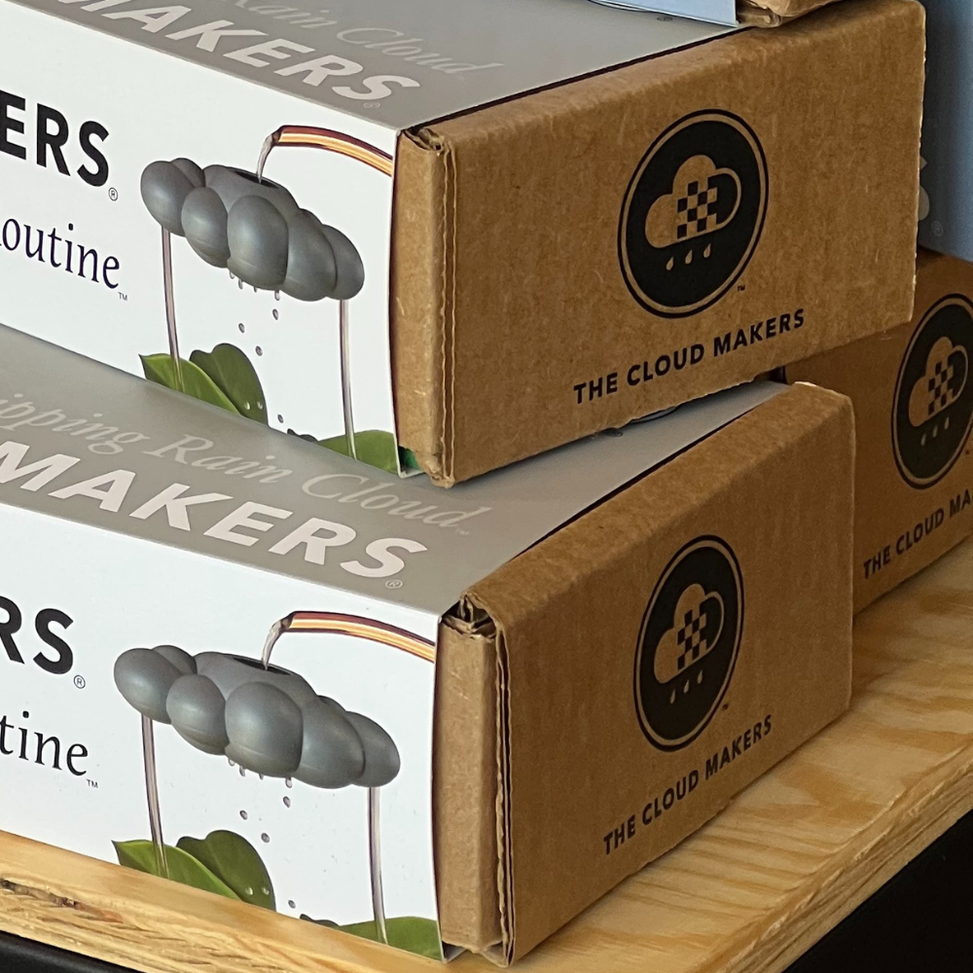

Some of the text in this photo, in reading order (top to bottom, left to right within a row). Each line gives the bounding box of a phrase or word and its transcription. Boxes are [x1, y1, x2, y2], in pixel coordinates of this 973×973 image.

[336, 27, 504, 75] Cloud
[573, 308, 806, 405] THE CLOUD MAKERS
[143, 433, 293, 485] Rain
[301, 473, 493, 529] Cloud
[863, 545, 890, 579] THE
[896, 508, 944, 555] CLOUD
[603, 714, 772, 855] THE CLOUD MAKERS
